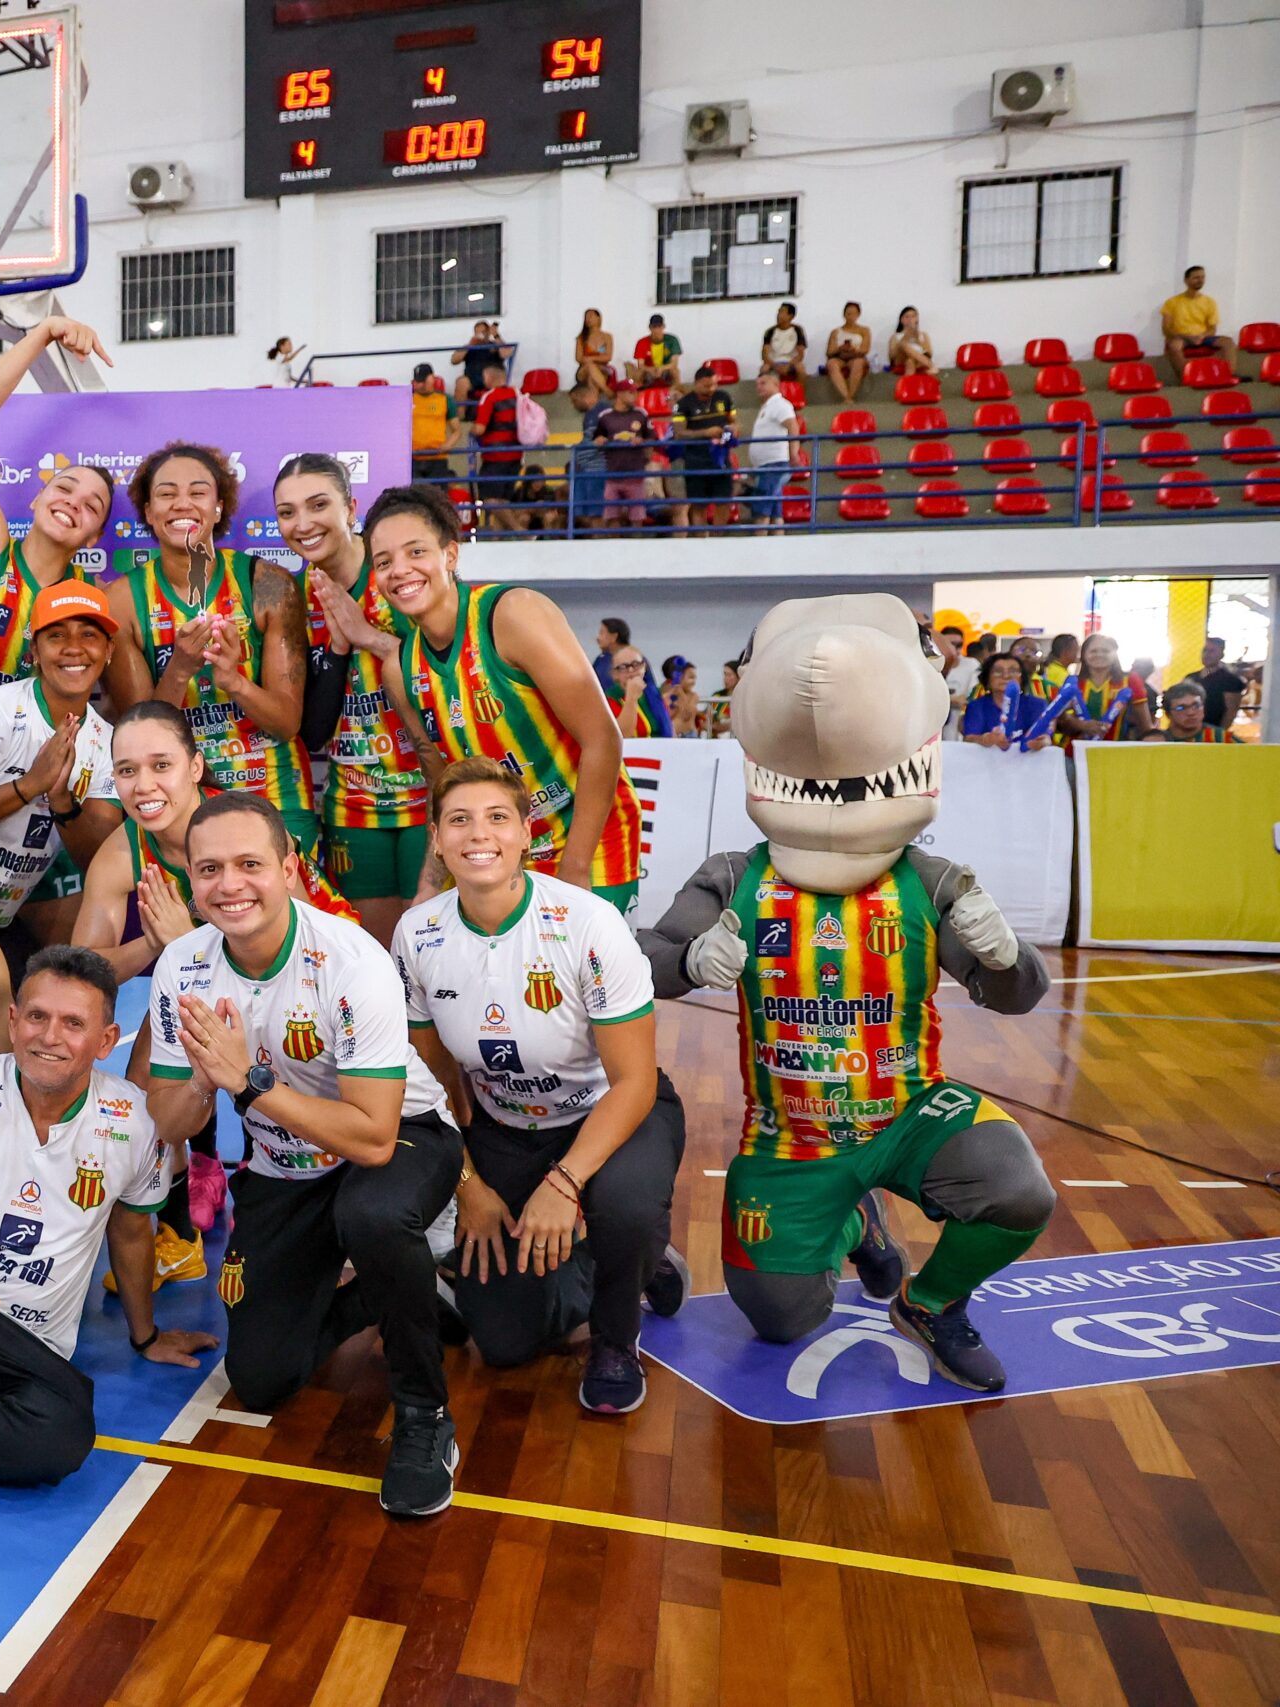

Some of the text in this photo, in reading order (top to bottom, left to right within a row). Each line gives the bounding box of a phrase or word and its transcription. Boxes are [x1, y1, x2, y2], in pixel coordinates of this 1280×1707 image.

[551, 37, 602, 79] 54
[285, 69, 331, 109] 65
[426, 67, 444, 93] 4
[543, 75, 600, 93] ESCORE
[279, 106, 331, 123] ESCORE
[575, 111, 586, 138] 1
[298, 140, 315, 166] 4
[406, 119, 485, 163] 0:00
[78, 451, 143, 467] loterias
[196, 723, 233, 736] NERGIA
[530, 782, 567, 808] EDEL
[764, 993, 894, 1026] equatorial
[799, 1025, 858, 1037] ENERGIA
[756, 1042, 866, 1074] MARANHÃO
[776, 1041, 814, 1051] GOVERNO
[554, 1087, 594, 1111] SEDEL
[785, 1093, 895, 1117] nutrimax
[10, 1200, 42, 1213] ENERGIA
